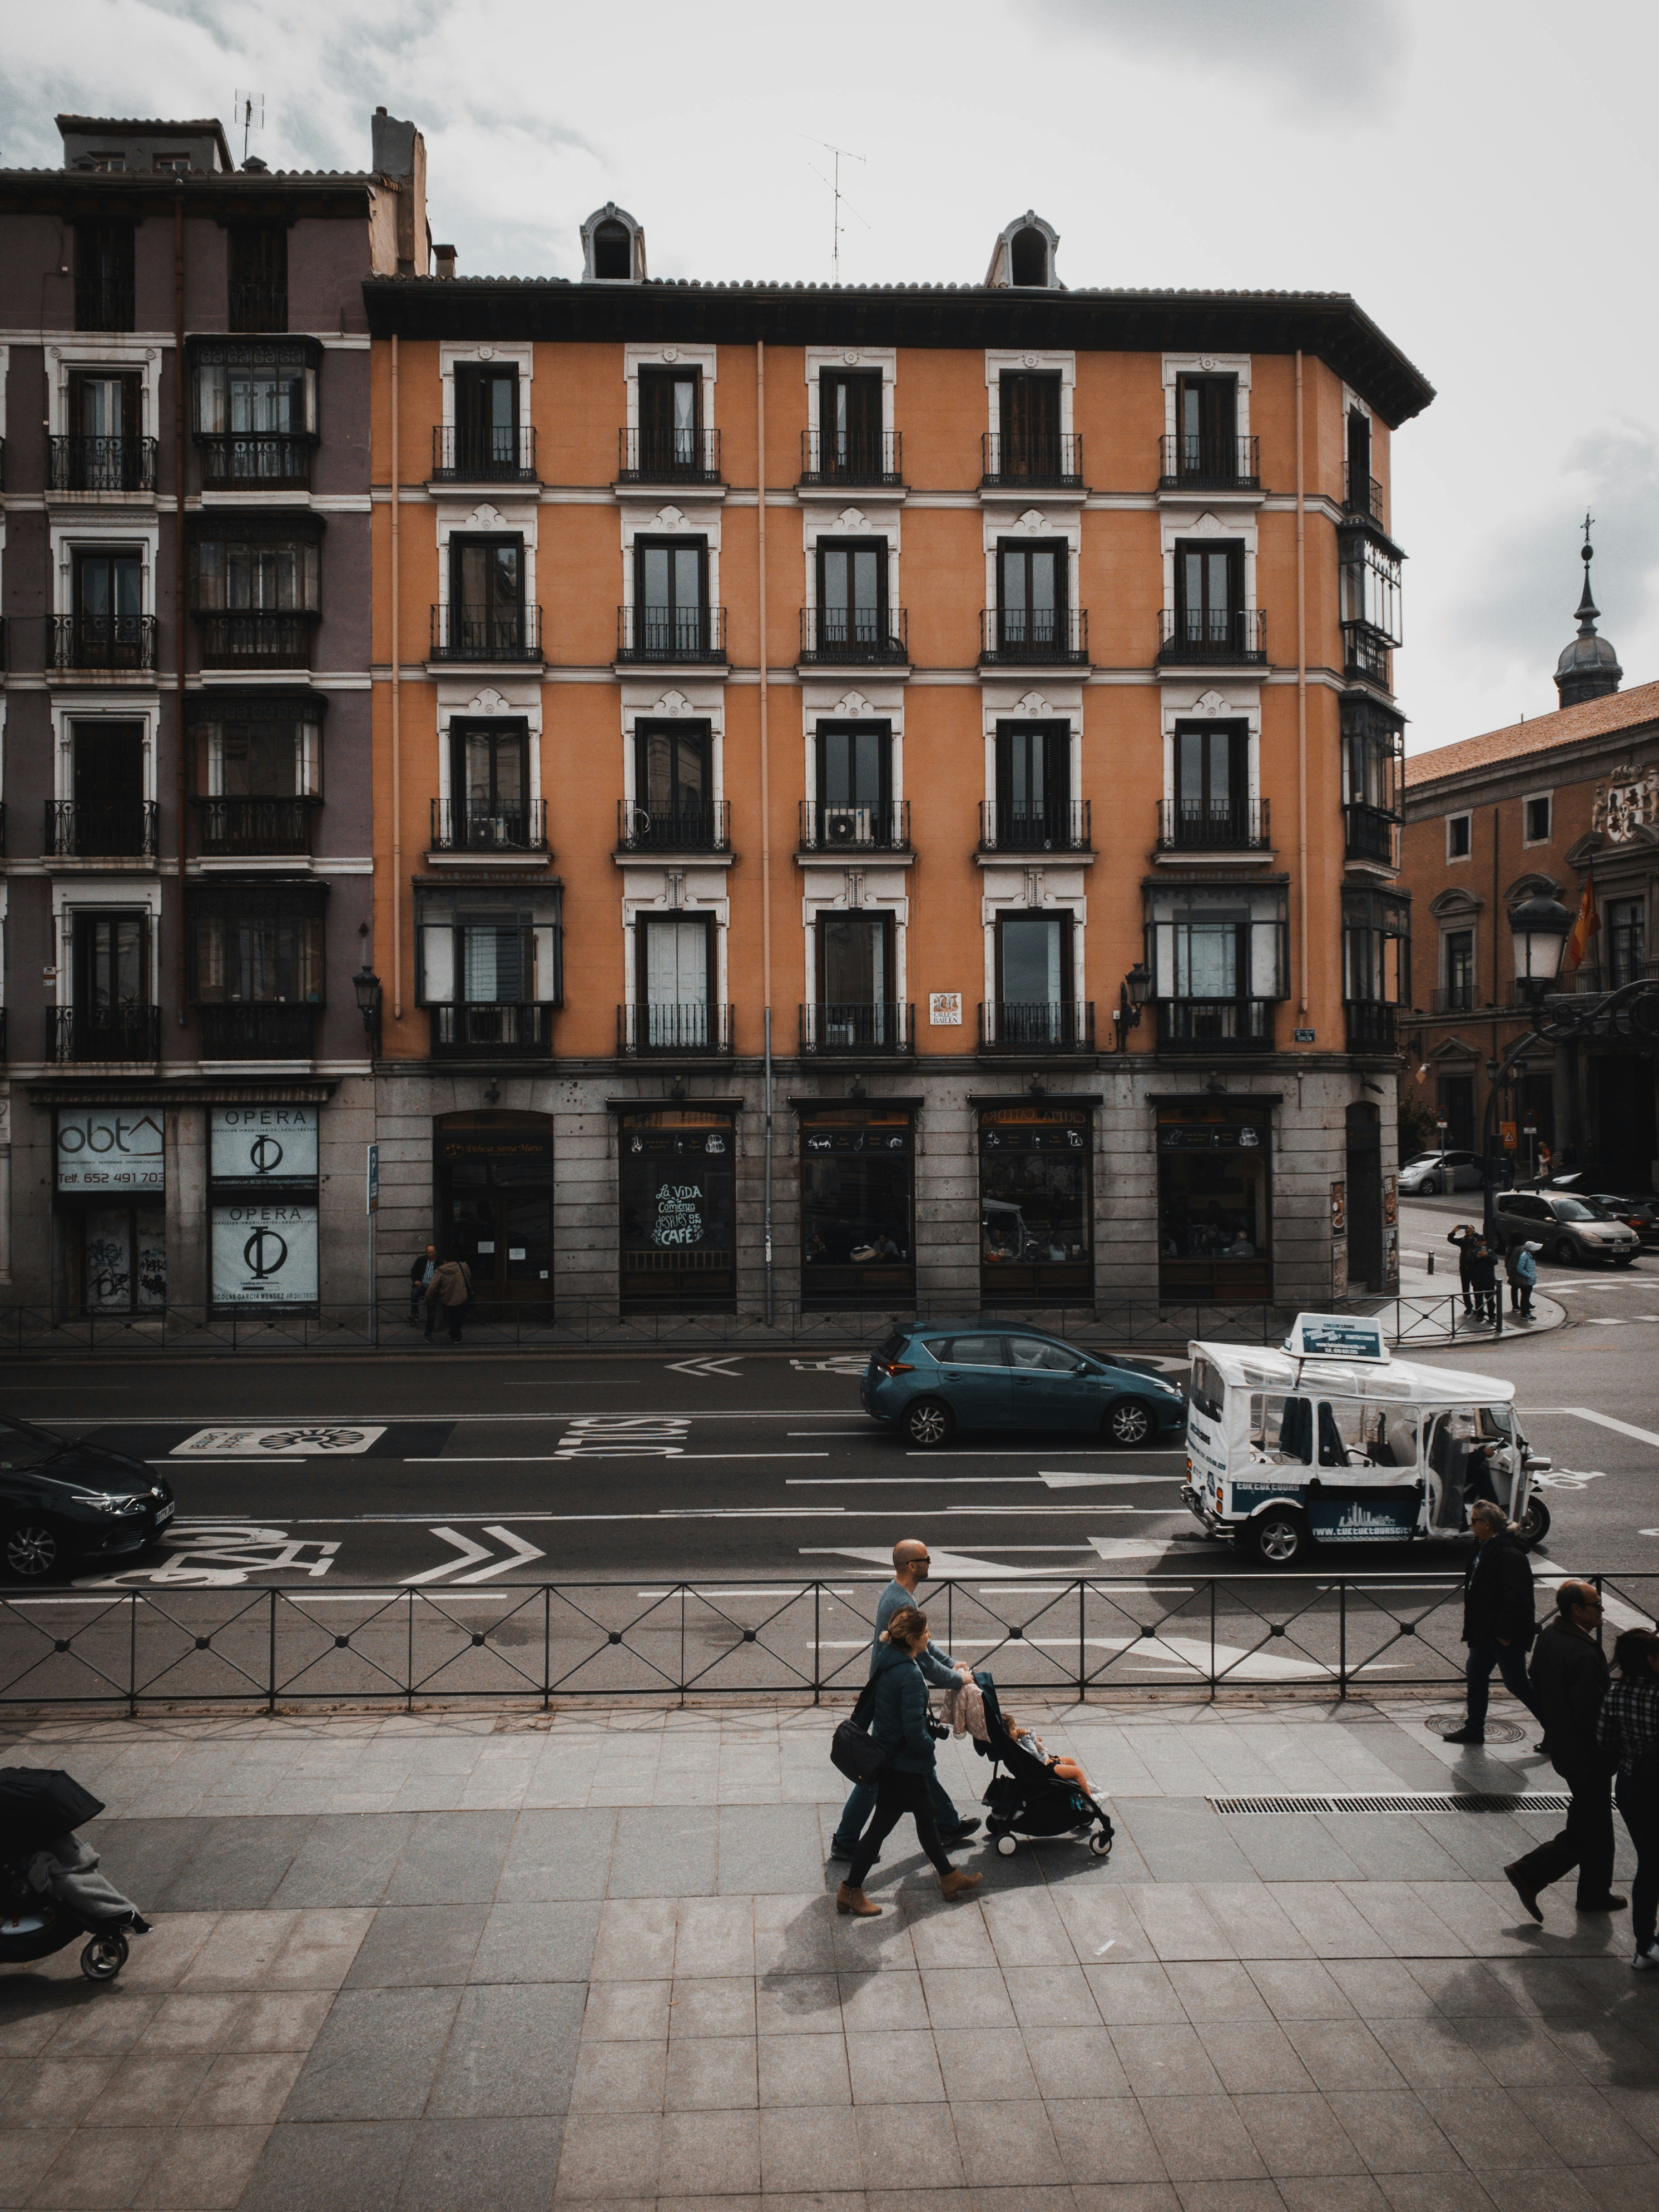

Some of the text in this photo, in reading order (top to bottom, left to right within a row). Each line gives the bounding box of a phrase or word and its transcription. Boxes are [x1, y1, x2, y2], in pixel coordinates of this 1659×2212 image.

[225, 1110, 306, 1125] OPERA
[466, 1144, 494, 1153] Dehesa
[372, 1152, 376, 1176] P
[58, 1172, 164, 1183] Telf. 652 491 703
[655, 1184, 671, 1200] La
[230, 1207, 301, 1220] OPERA
[658, 1201, 696, 1214] Comienza
[661, 1225, 694, 1245] CAFÉ
[187, 1432, 228, 1449] Central
[216, 1432, 255, 1448] Madrid
[553, 1418, 692, 1457] SOLO
